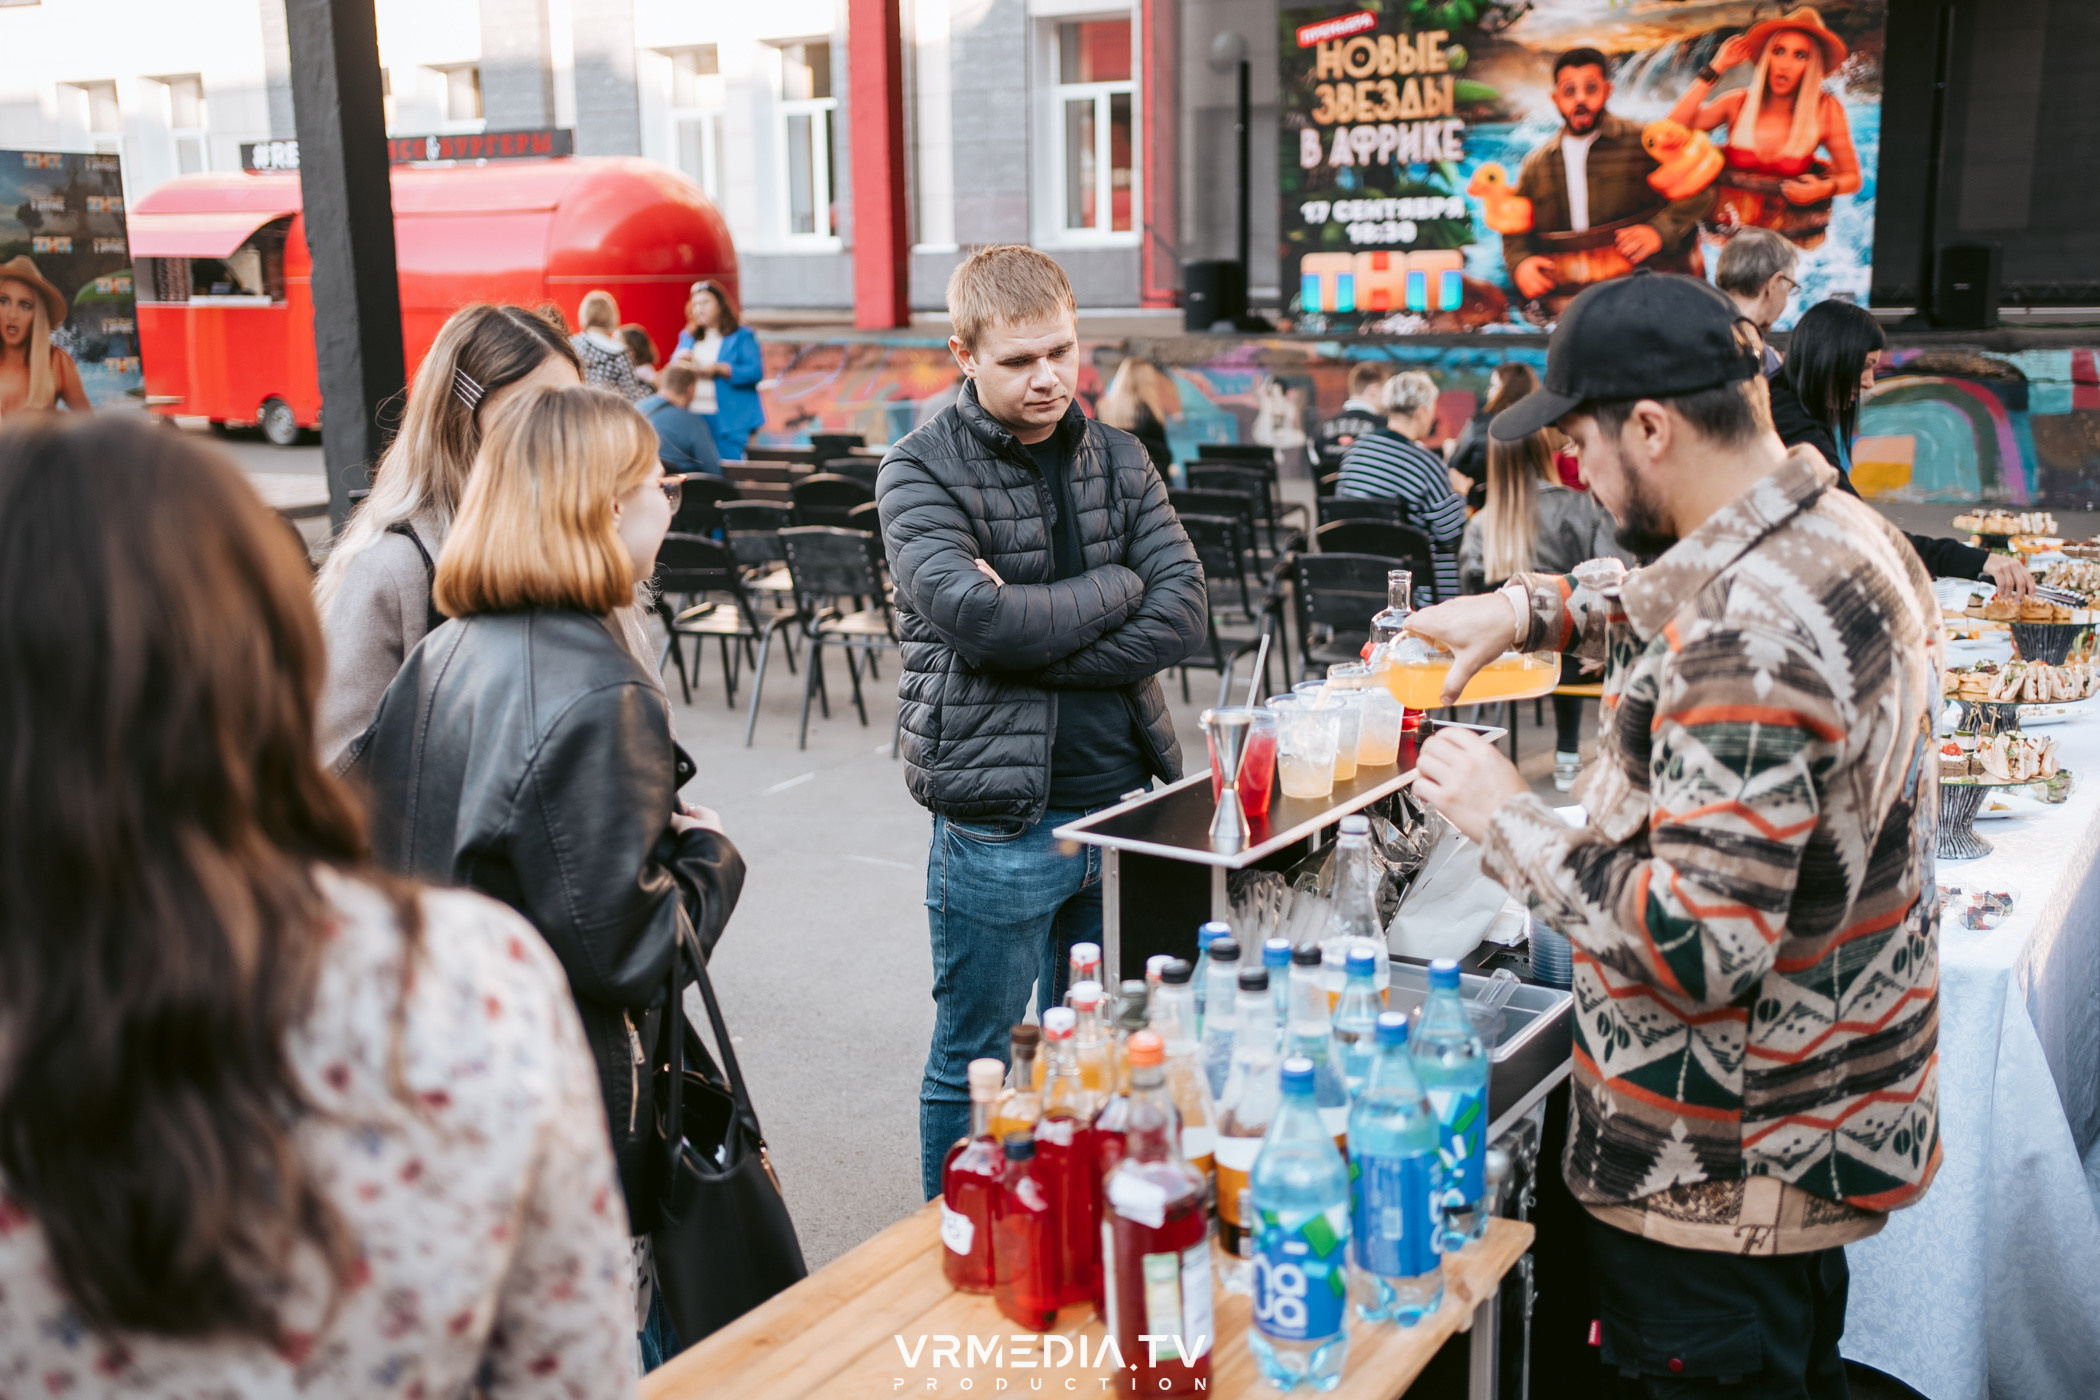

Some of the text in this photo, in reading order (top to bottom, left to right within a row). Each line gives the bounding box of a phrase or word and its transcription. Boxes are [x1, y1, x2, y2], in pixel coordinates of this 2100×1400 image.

[1316, 29, 1449, 80] НОВЫЕ
[1311, 75, 1454, 125] ЗВЕЗДЫ
[439, 131, 553, 159] БУРГЕРЫ
[1300, 119, 1465, 169] В АФРИКЕ
[1300, 196, 1466, 224] 17 СЕНТЯБРЯ
[1301, 249, 1464, 312] ТНТ
